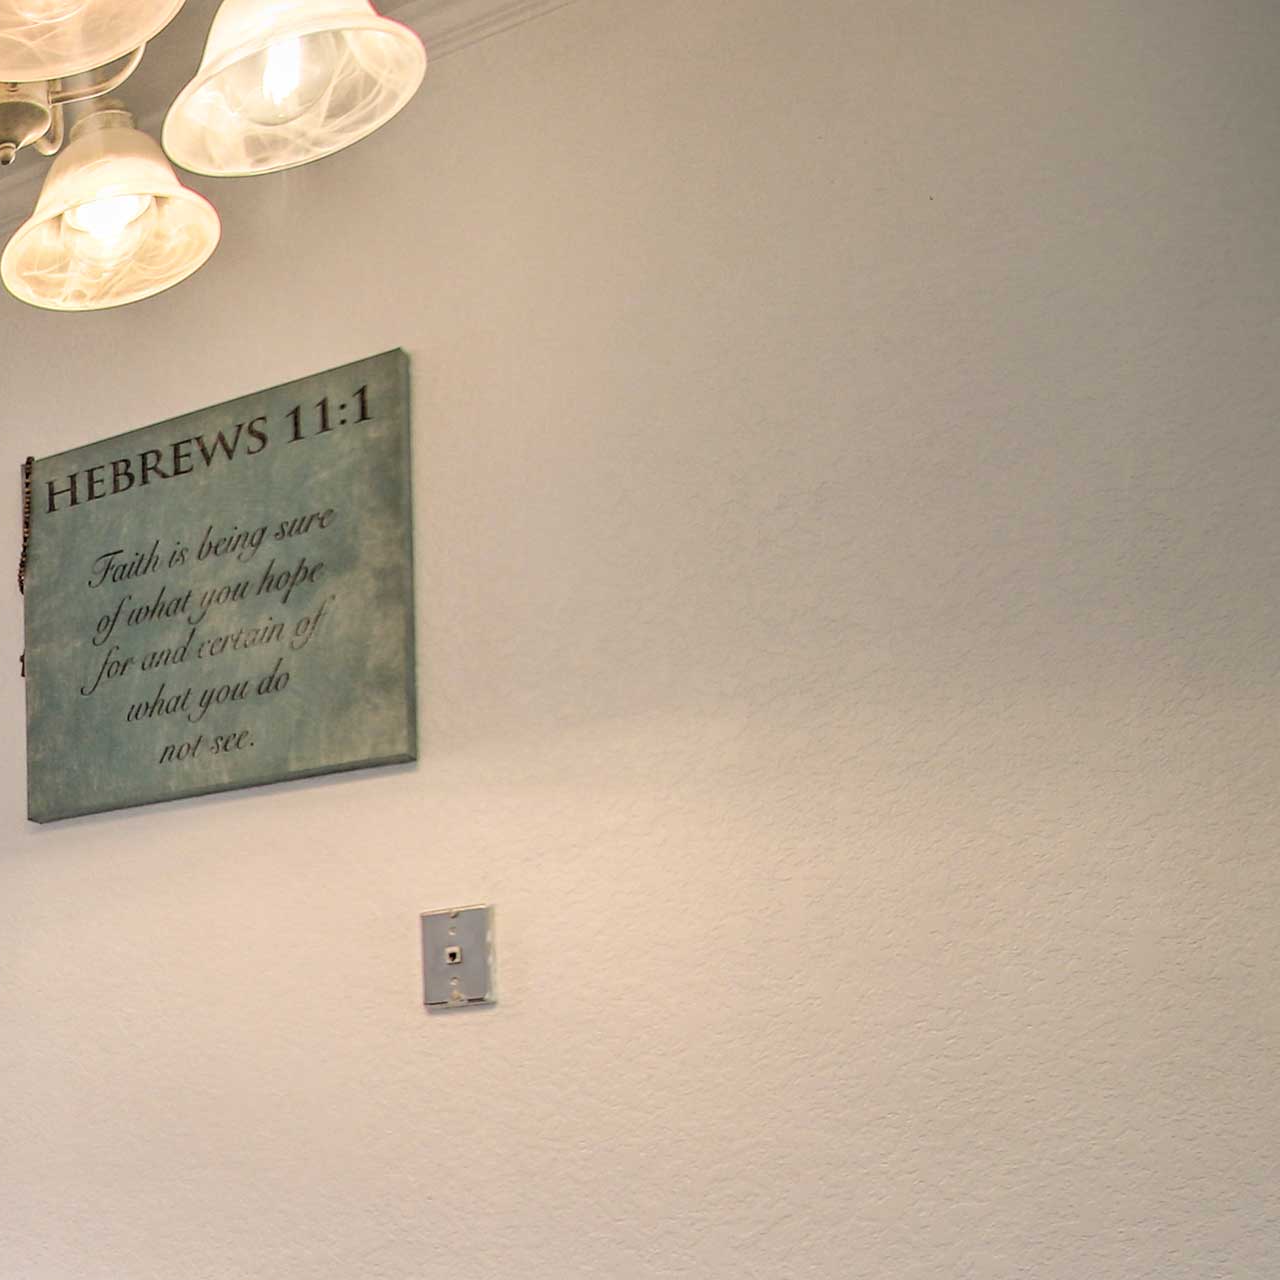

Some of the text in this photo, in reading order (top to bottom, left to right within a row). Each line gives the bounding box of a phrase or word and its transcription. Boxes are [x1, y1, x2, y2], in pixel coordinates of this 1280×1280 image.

[45, 385, 375, 513] HEBREWS 11:1
[88, 505, 335, 589] Faith is being sure
[80, 594, 334, 697] for and certain of
[92, 558, 325, 648] of what you hope
[126, 657, 291, 722] what you do
[159, 728, 255, 765] not see.
